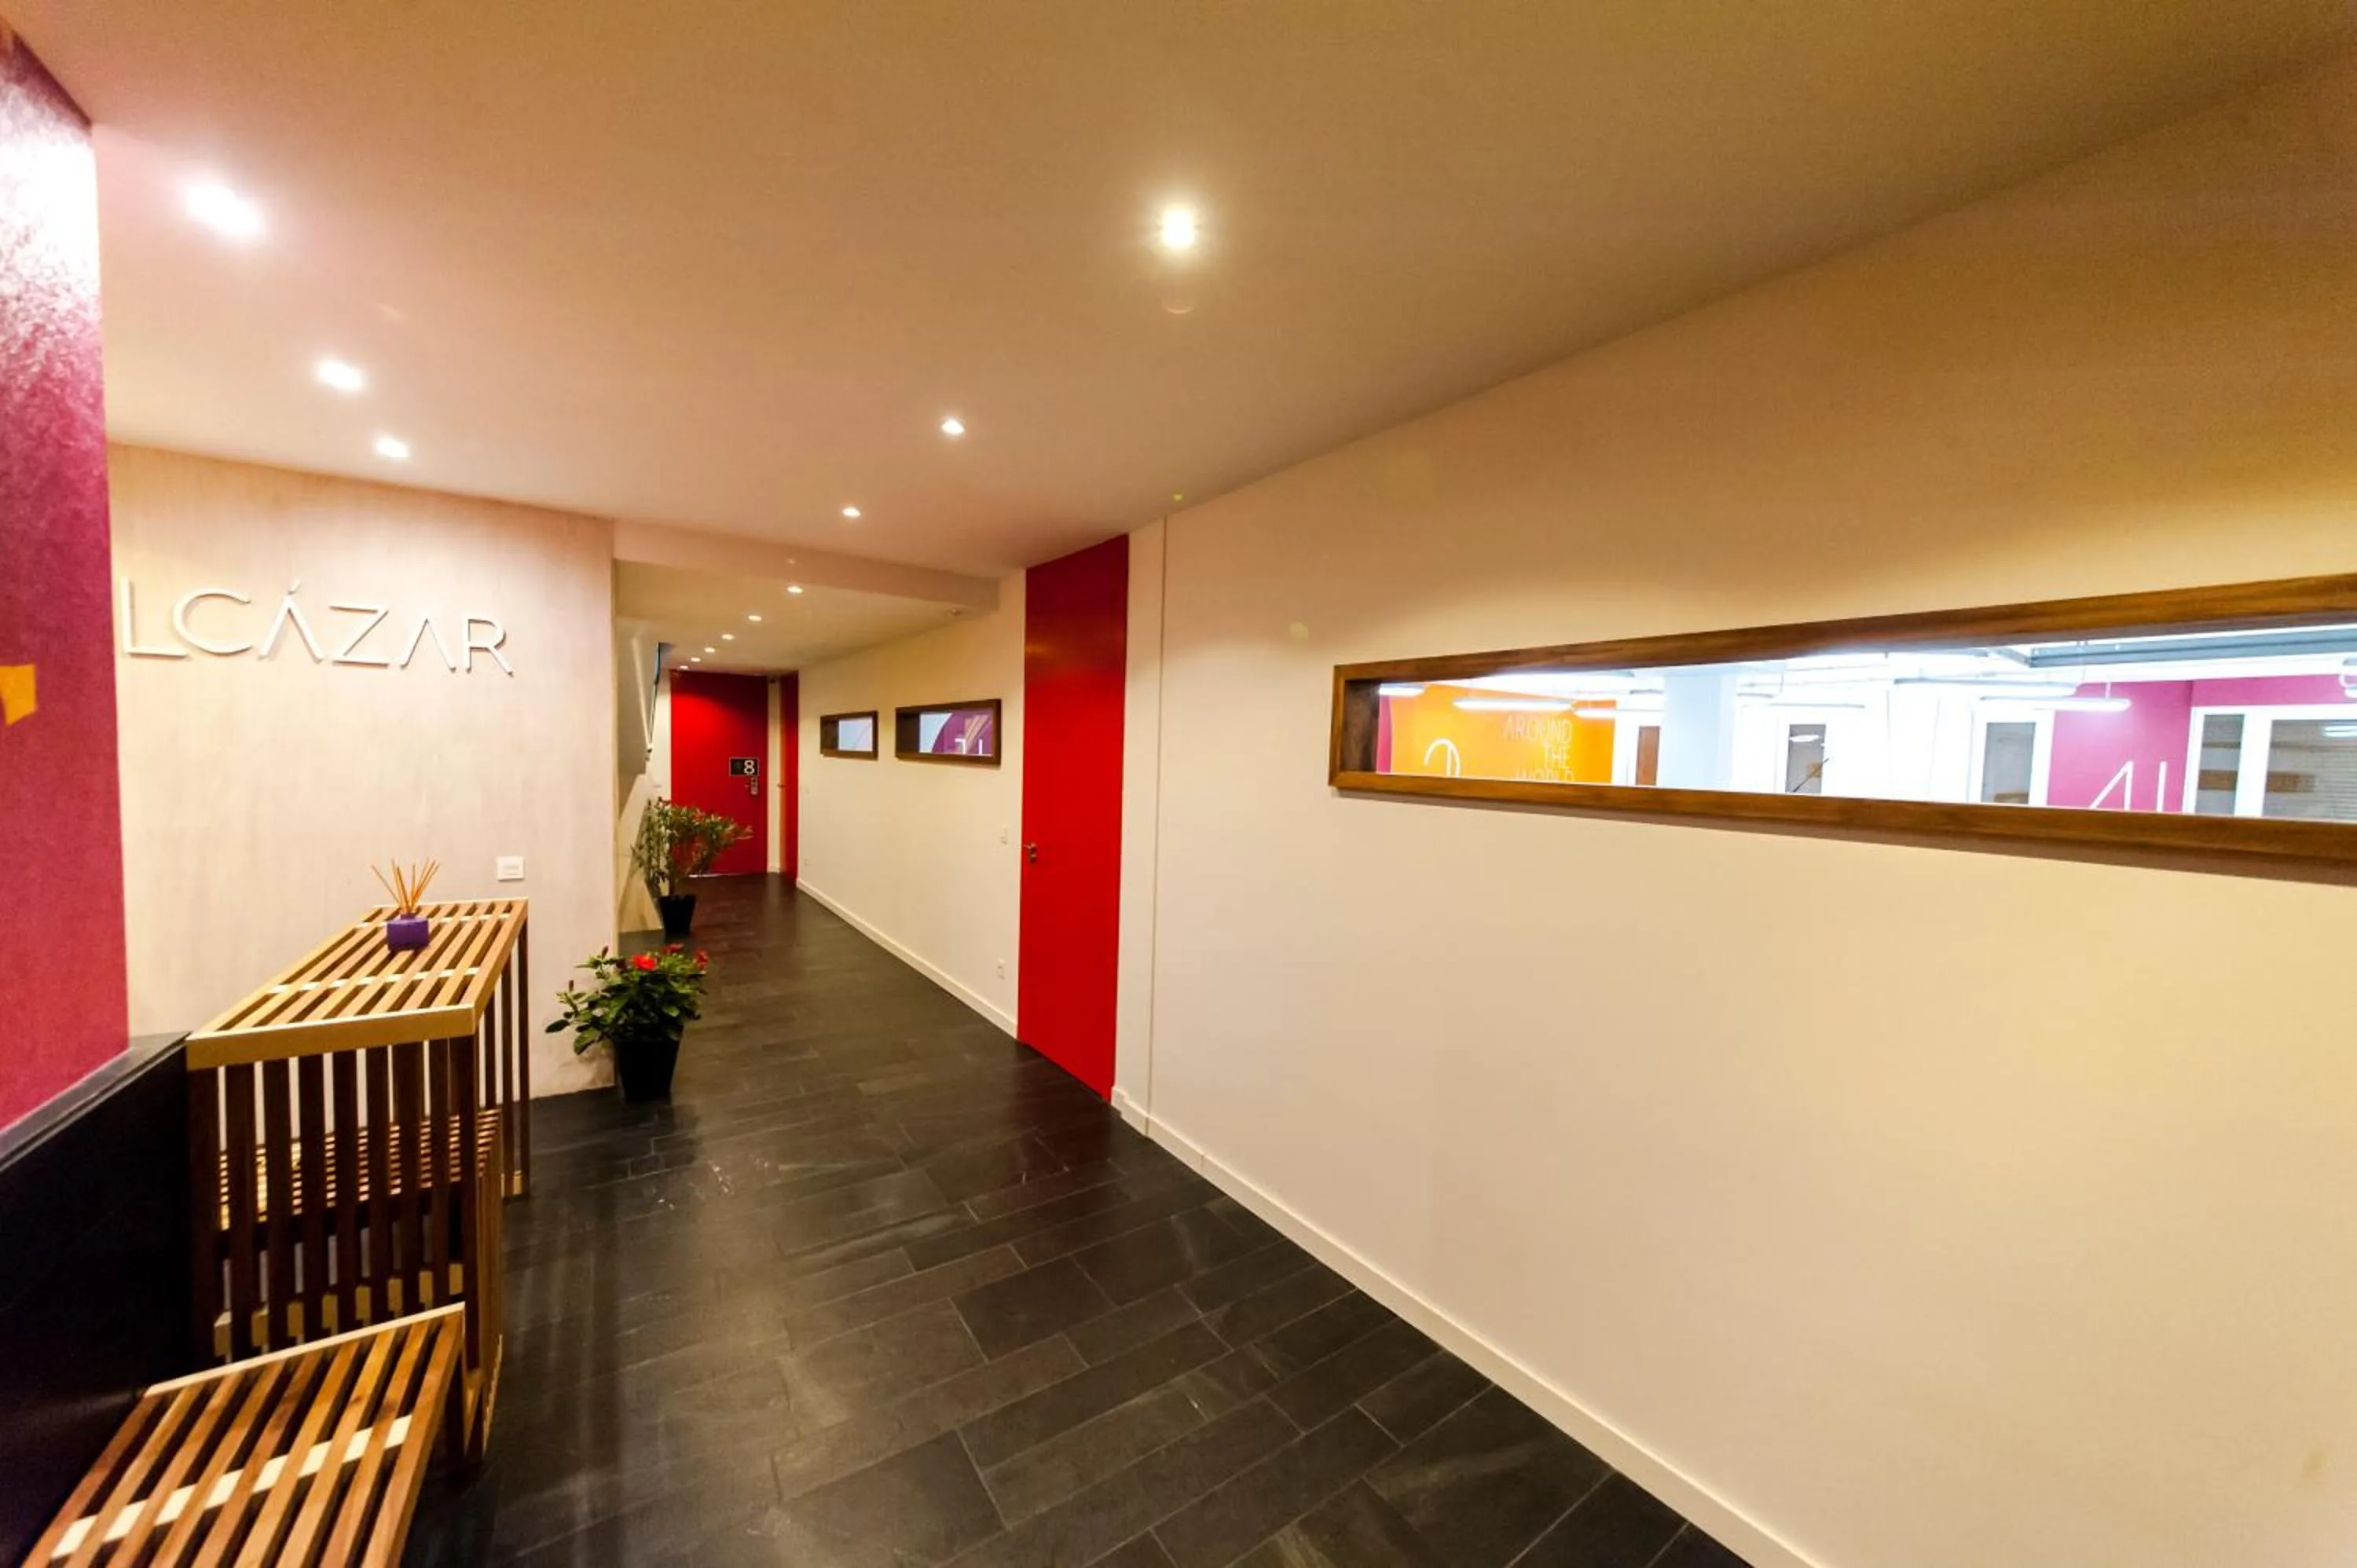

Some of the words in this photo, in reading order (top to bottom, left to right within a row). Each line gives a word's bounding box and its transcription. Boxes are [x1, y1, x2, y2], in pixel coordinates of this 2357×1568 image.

[1505, 716, 1572, 743] AROUND
[744, 760, 755, 775] 8
[1543, 743, 1571, 769] THE
